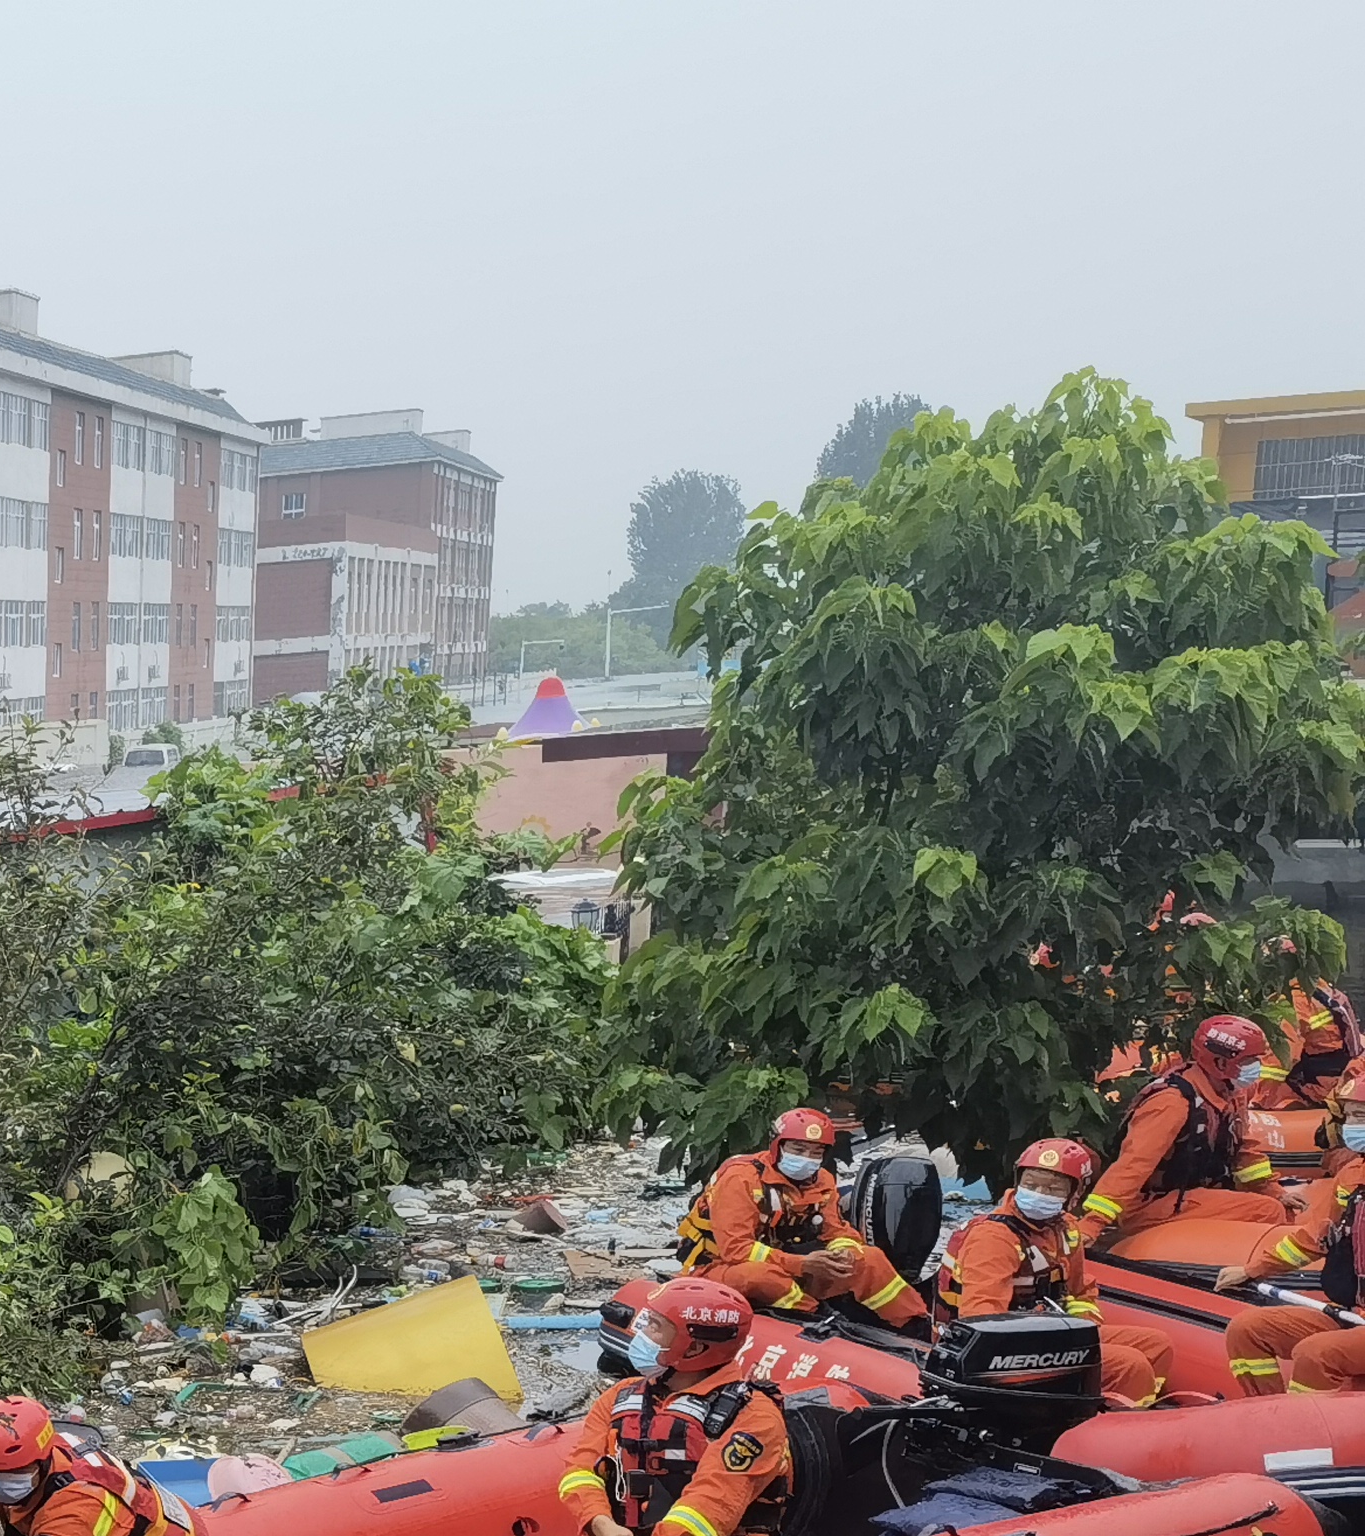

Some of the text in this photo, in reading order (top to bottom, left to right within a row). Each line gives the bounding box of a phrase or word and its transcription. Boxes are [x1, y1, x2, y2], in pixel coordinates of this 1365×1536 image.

[681, 1305, 741, 1324] 北京消防
[988, 1349, 1090, 1370] MERCURY
